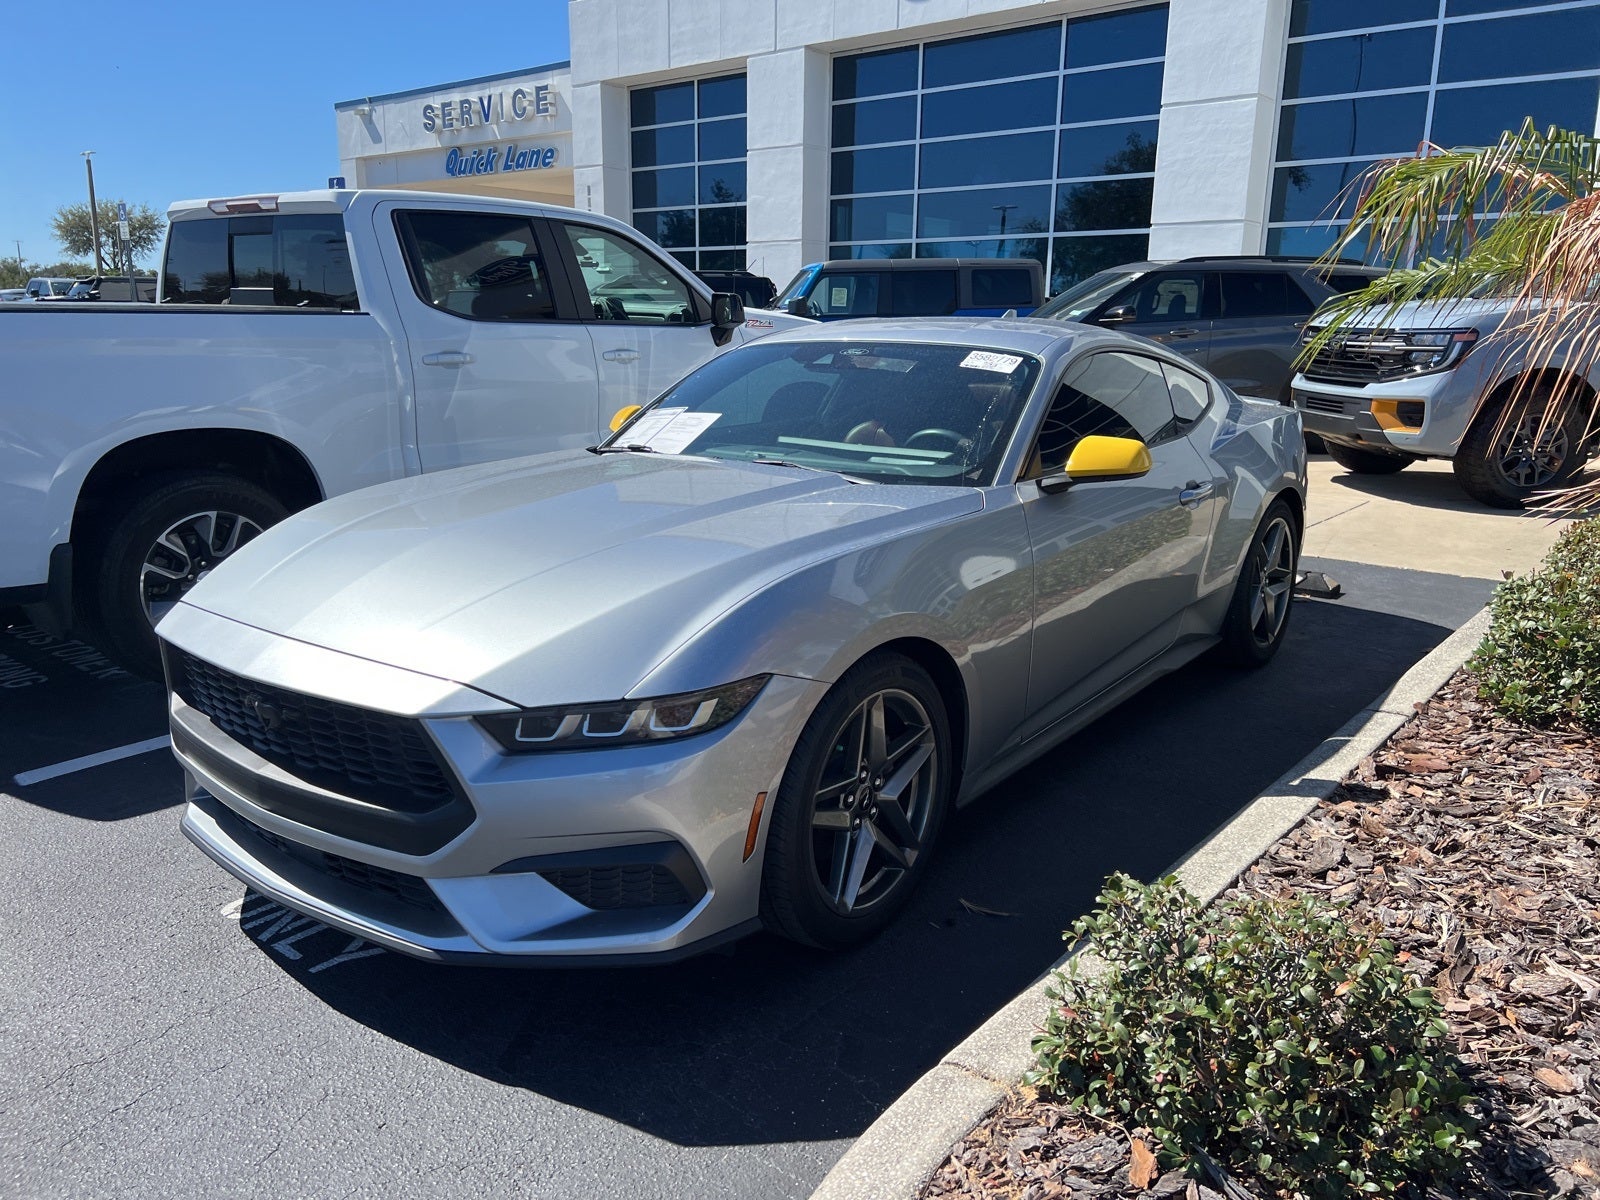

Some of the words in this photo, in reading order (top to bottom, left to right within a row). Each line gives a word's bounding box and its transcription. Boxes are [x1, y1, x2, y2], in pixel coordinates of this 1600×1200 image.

[423, 84, 554, 133] SERVICE
[446, 147, 498, 177] Quick
[503, 144, 556, 172] Lane
